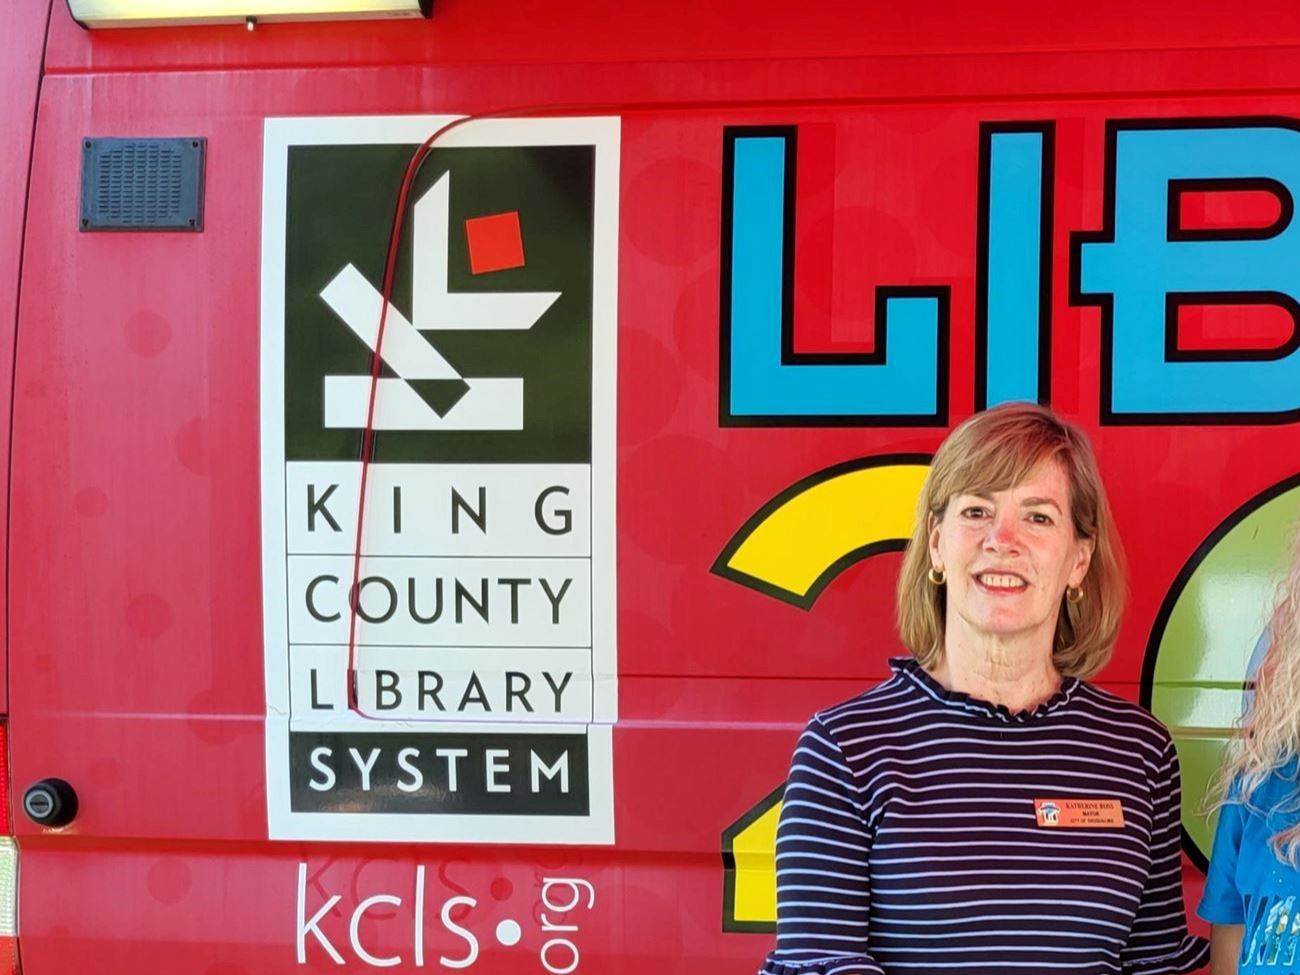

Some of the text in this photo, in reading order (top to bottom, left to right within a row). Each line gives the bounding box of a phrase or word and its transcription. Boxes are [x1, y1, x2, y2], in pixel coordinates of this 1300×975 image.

[307, 484, 573, 536] KING
[305, 575, 573, 625] COUNTY
[310, 668, 573, 713] LIBRARY
[308, 746, 569, 793] SYSTEM
